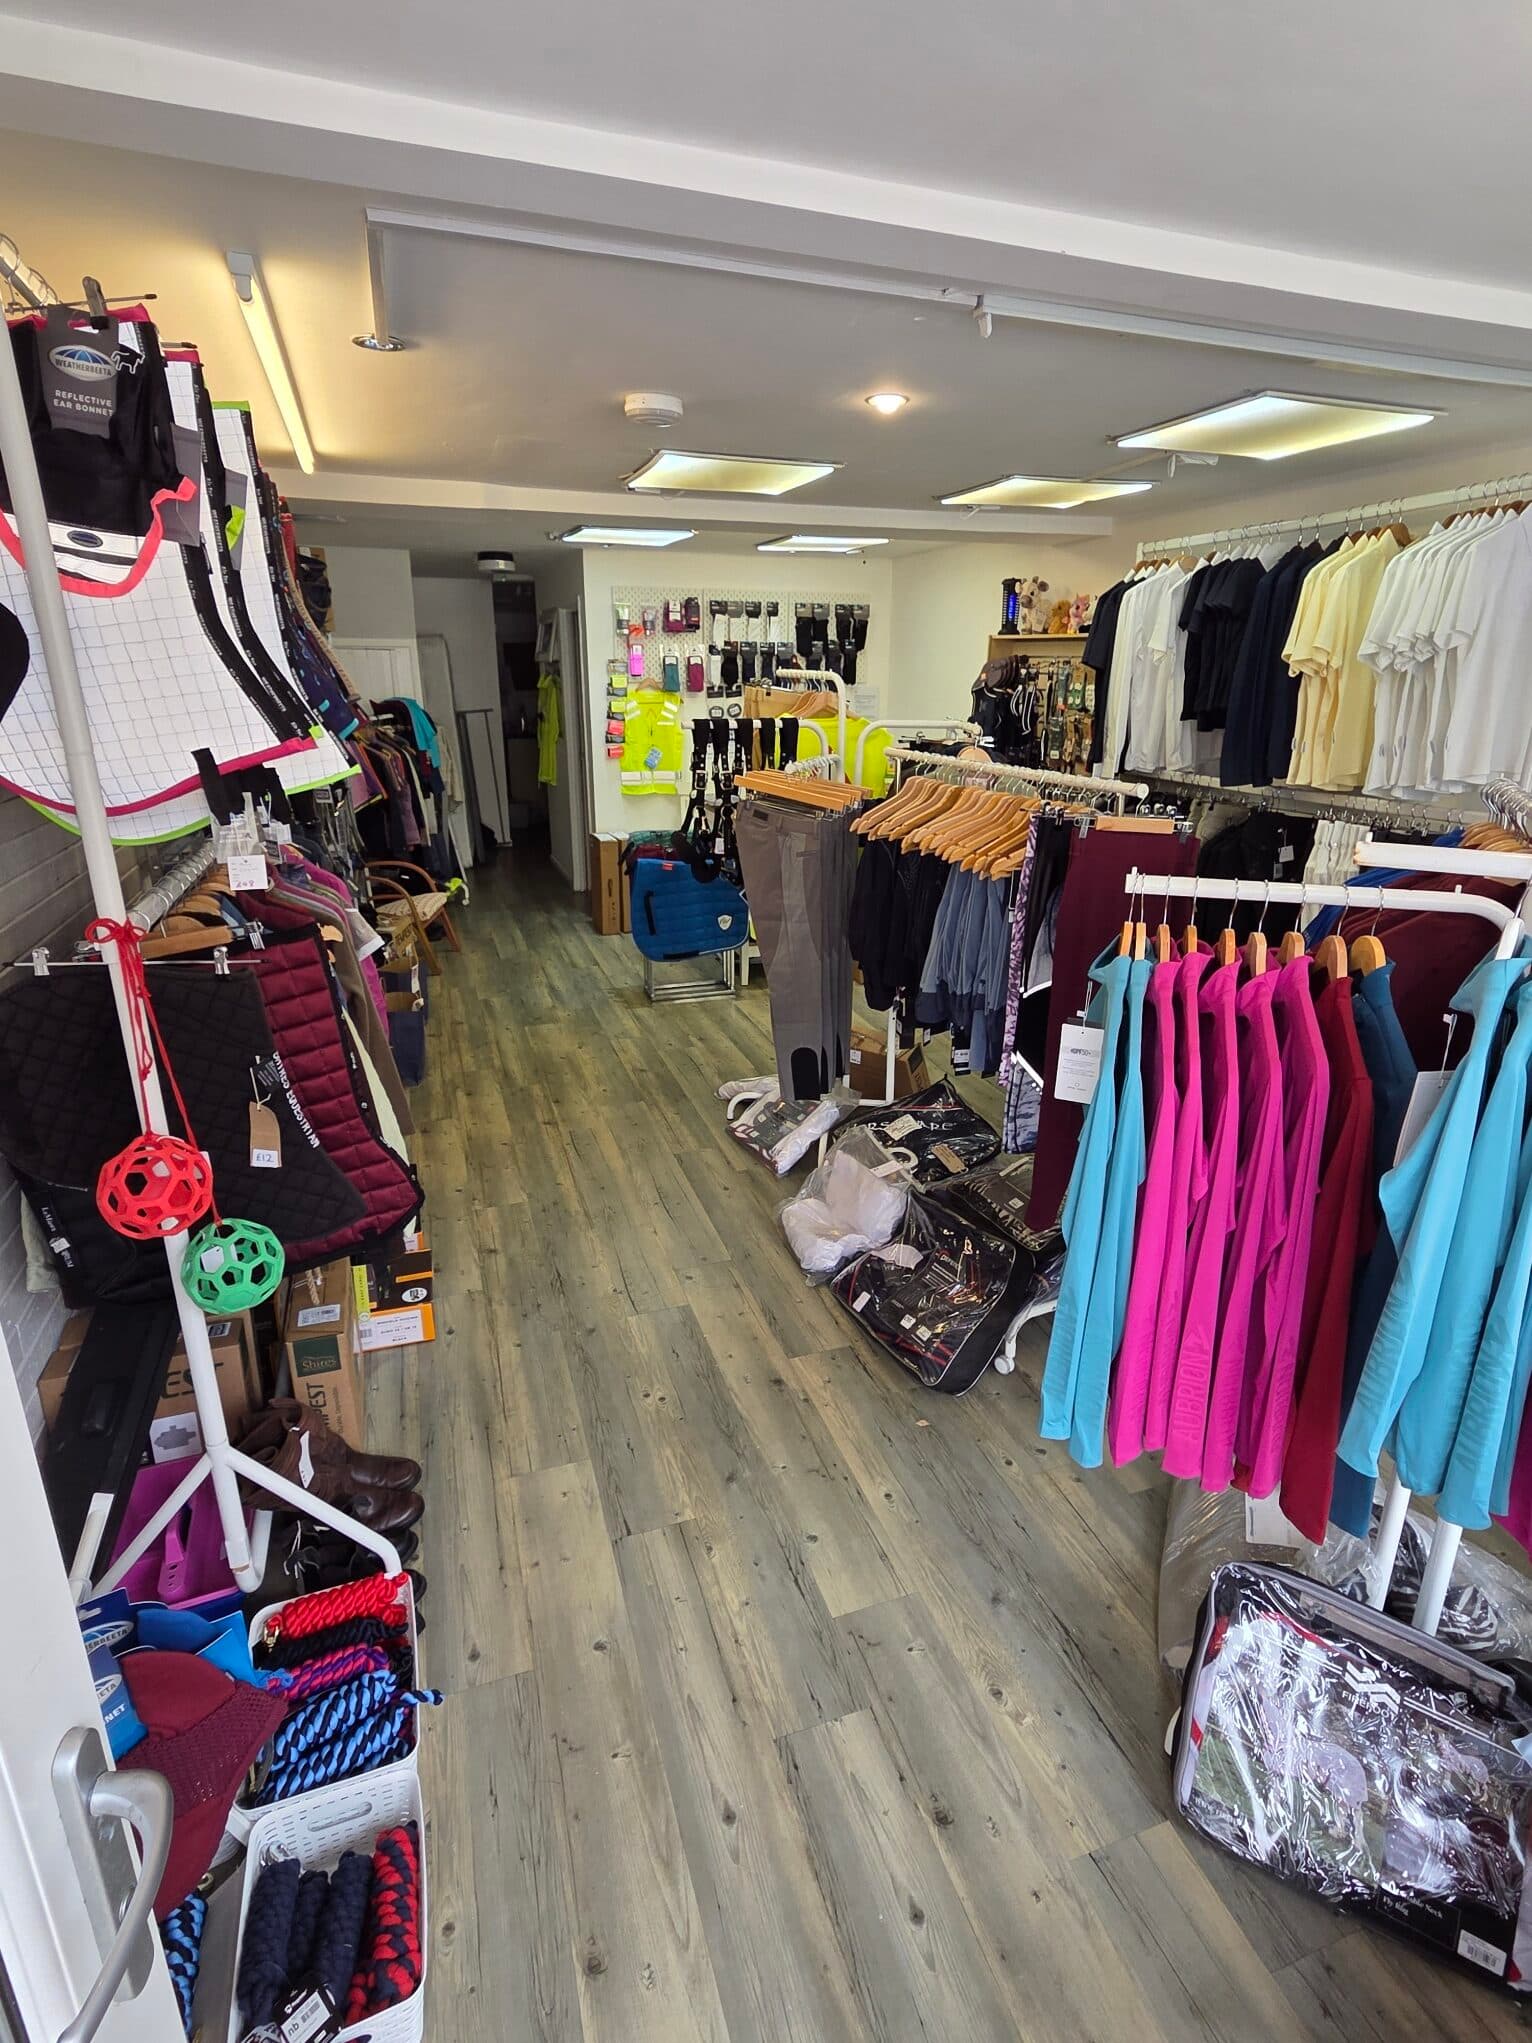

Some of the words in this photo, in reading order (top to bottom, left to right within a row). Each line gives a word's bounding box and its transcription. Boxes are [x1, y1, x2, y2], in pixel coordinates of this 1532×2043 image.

[55, 358, 112, 376] WEATHERBEETA
[55, 389, 112, 407] REFLECTIVE
[53, 399, 73, 409] EAR
[75, 403, 114, 416] BONNET
[286, 1089, 320, 1149] EQUESTRIAN
[256, 1153, 275, 1163] £12
[302, 1359, 337, 1370] Shires
[1173, 1349, 1211, 1440] AUBRION
